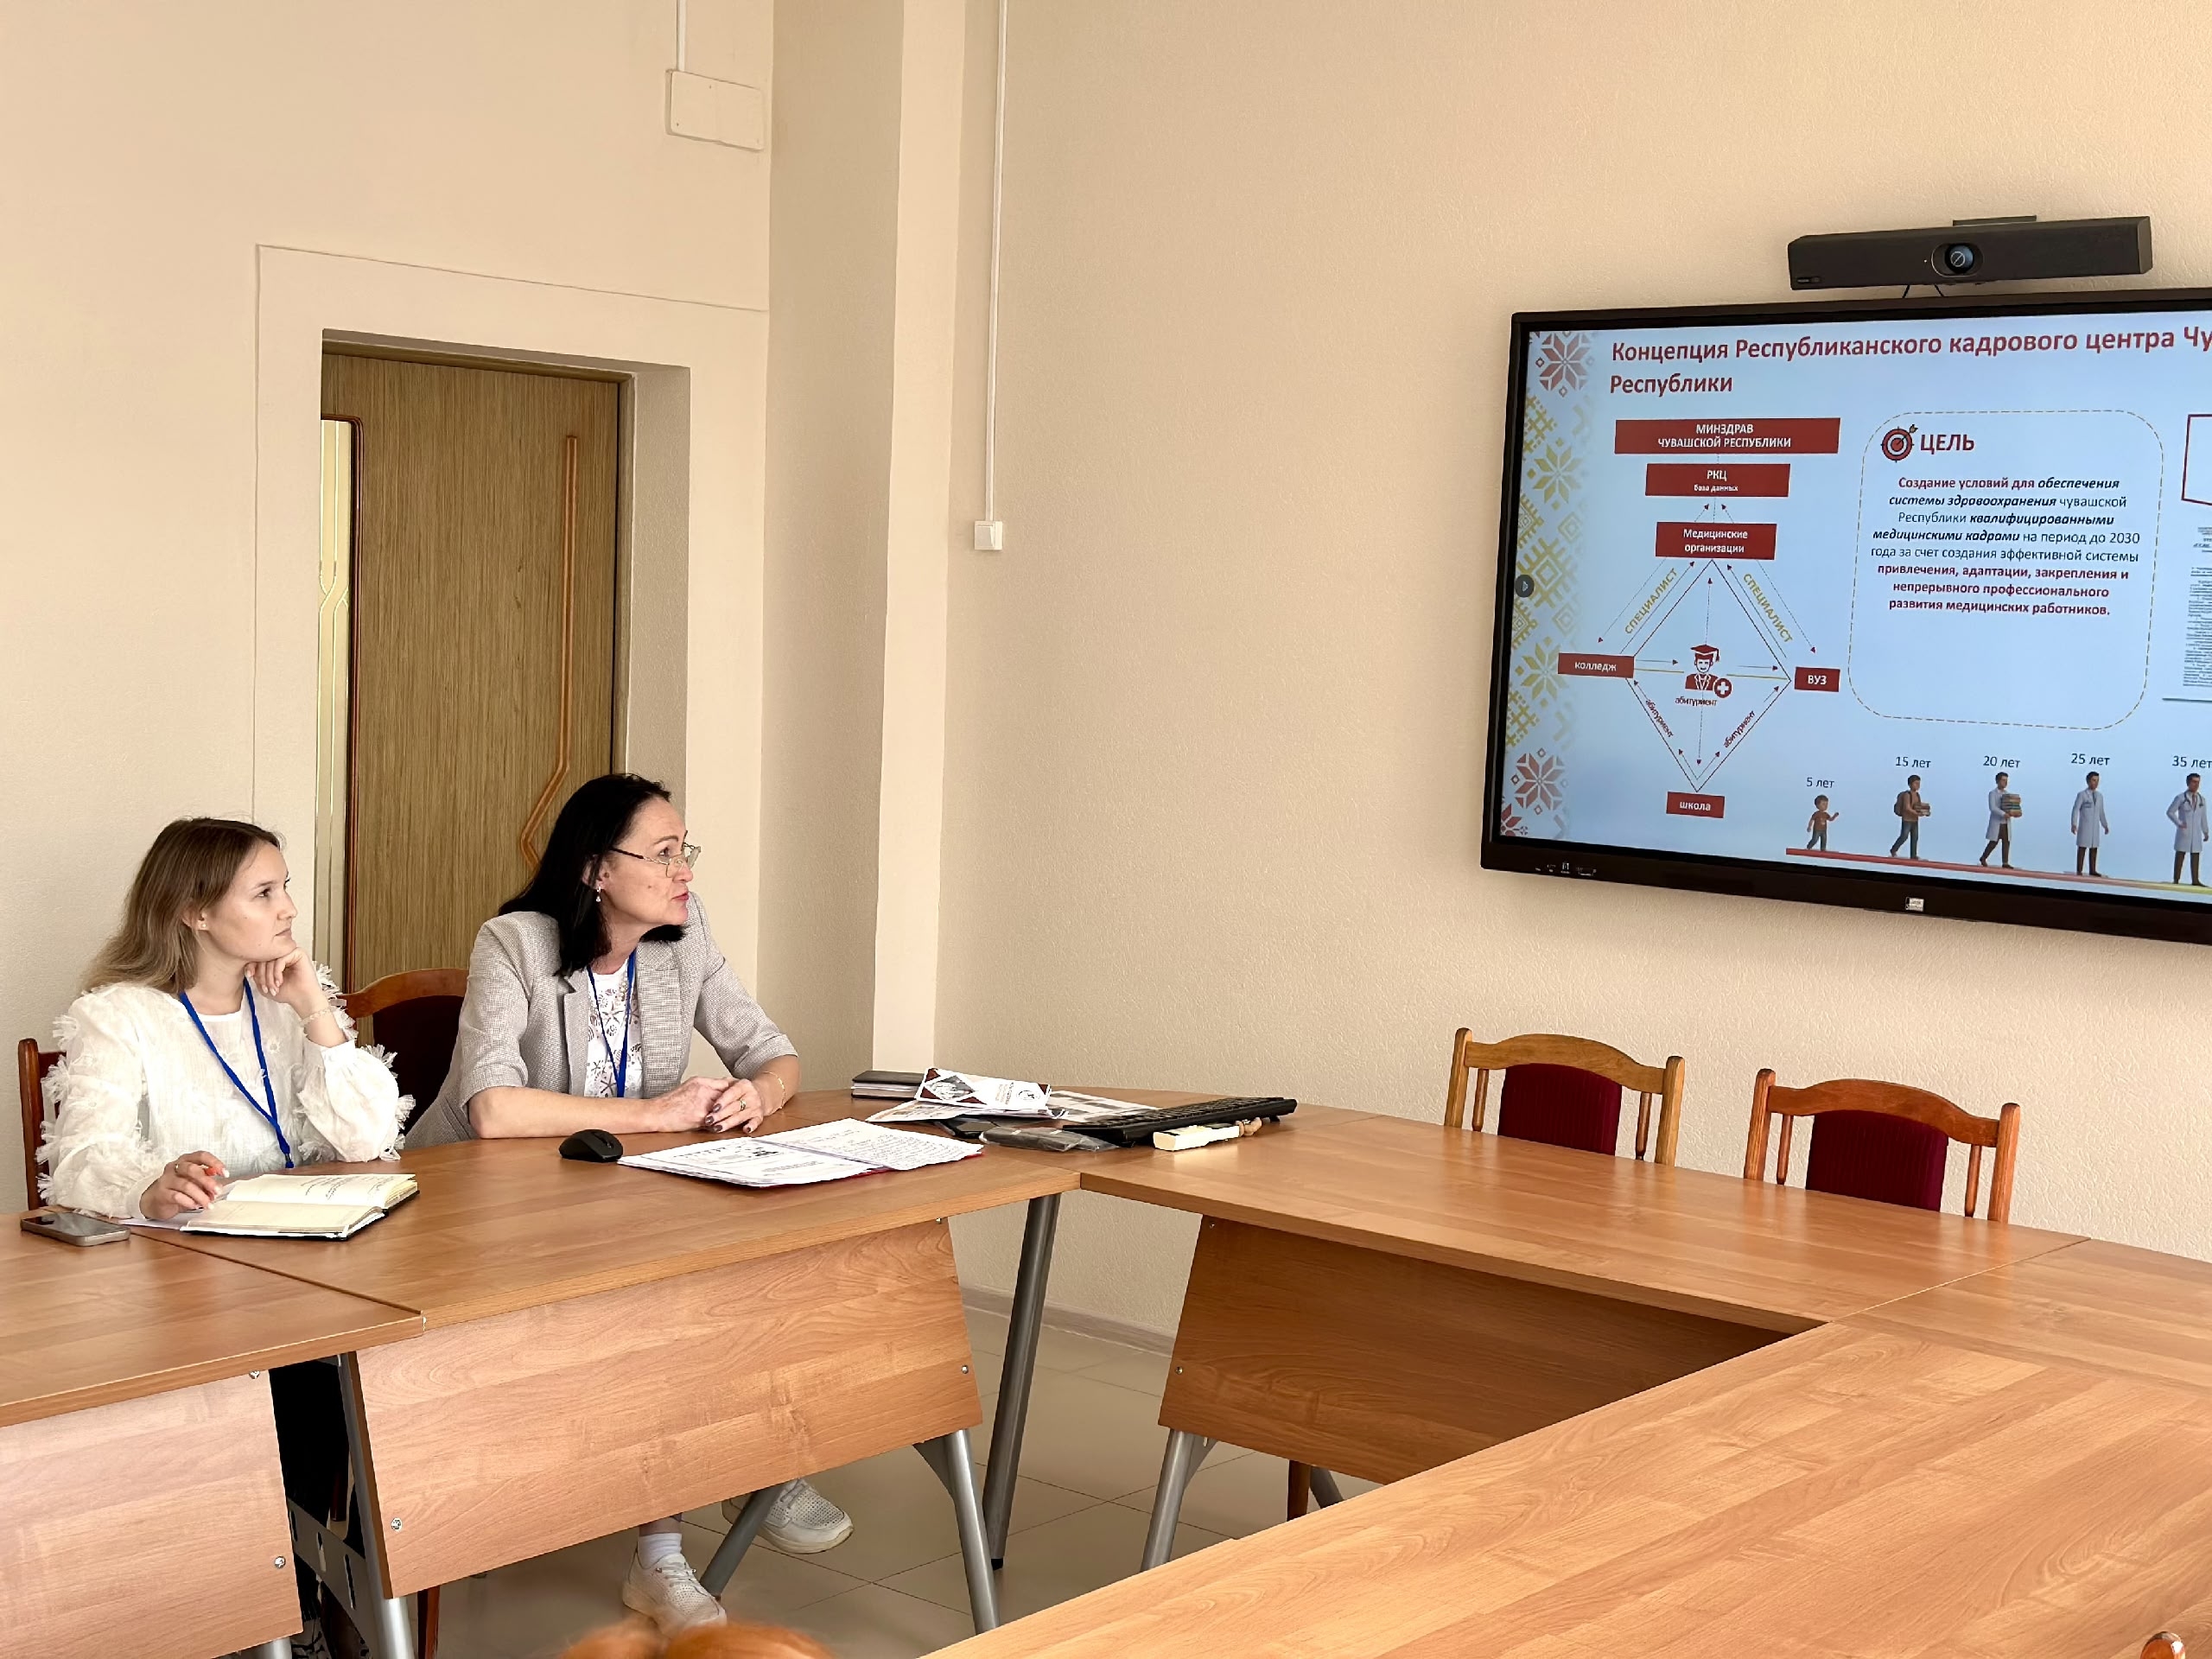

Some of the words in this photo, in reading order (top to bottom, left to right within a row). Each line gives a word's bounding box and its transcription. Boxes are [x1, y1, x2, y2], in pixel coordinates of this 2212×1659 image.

[1612, 342, 1728, 364] Концепция
[1736, 335, 1942, 361] Республиканского
[1949, 333, 2077, 356] кадрового
[2086, 329, 2174, 353] центра
[1611, 373, 1732, 397] Республики
[1695, 424, 1753, 435] МИНЗДРАВ
[1658, 436, 1720, 448] ЧУВАШСКОЙ
[1724, 438, 1791, 448] РЕСПУБЛИКИ
[1920, 434, 1974, 454] ЦЕЛЬ
[1707, 470, 1726, 481] РКЦ
[1898, 477, 1955, 489] Создание
[1959, 477, 2008, 491] условий
[2012, 479, 2034, 490] для
[2038, 477, 2119, 489] обеспечения
[1889, 496, 1944, 505] системы
[1948, 495, 2056, 508] здравоохранения
[2060, 497, 2126, 508] чувашской
[1899, 512, 1967, 524] Республики
[1970, 513, 2113, 526] квалифицированными
[1683, 529, 1748, 540] Медицинские
[1873, 530, 1962, 542] медицинскими
[1966, 531, 2019, 543] кадрами
[2023, 534, 2037, 543] на
[2041, 534, 2086, 544] период
[2089, 534, 2106, 544] до
[2109, 532, 2139, 543] 2030
[1685, 543, 1745, 555] организации
[1871, 548, 1896, 558] года
[1900, 548, 1911, 556] за
[1915, 549, 1939, 557] счет
[1942, 549, 1997, 560] создания
[2000, 548, 2082, 562] эффективной
[2086, 552, 2139, 562] системы
[1878, 564, 1959, 576] привлечения,
[1962, 567, 2031, 578] адаптации,
[2035, 569, 2117, 580] закрепления
[1893, 582, 1980, 594] непрерывного
[1983, 584, 2109, 598] профессионального
[1624, 568, 1677, 634] СПЕЦИАЛИСТ
[1889, 600, 1943, 612] развития
[1946, 601, 2029, 613] медицинских
[2032, 602, 2110, 615] работников.
[1743, 574, 1793, 644] СПЕЦИАЛИСТ
[1575, 660, 1617, 672] колледж
[1808, 675, 1827, 685] ВУЗ
[1675, 696, 1717, 706] абитуриент
[1646, 699, 1674, 737] абитуриент
[1723, 710, 1755, 748] абитуриент
[1895, 756, 1909, 767] 15
[1911, 759, 1931, 768] лет
[1983, 756, 1999, 766] 20
[2001, 758, 2020, 768] лет
[2071, 753, 2086, 765] 25
[2089, 755, 2110, 766] лет
[2172, 755, 2187, 767] 35
[1807, 778, 1813, 787] 5
[1815, 779, 1834, 788] лет
[1680, 801, 1711, 811] школа
